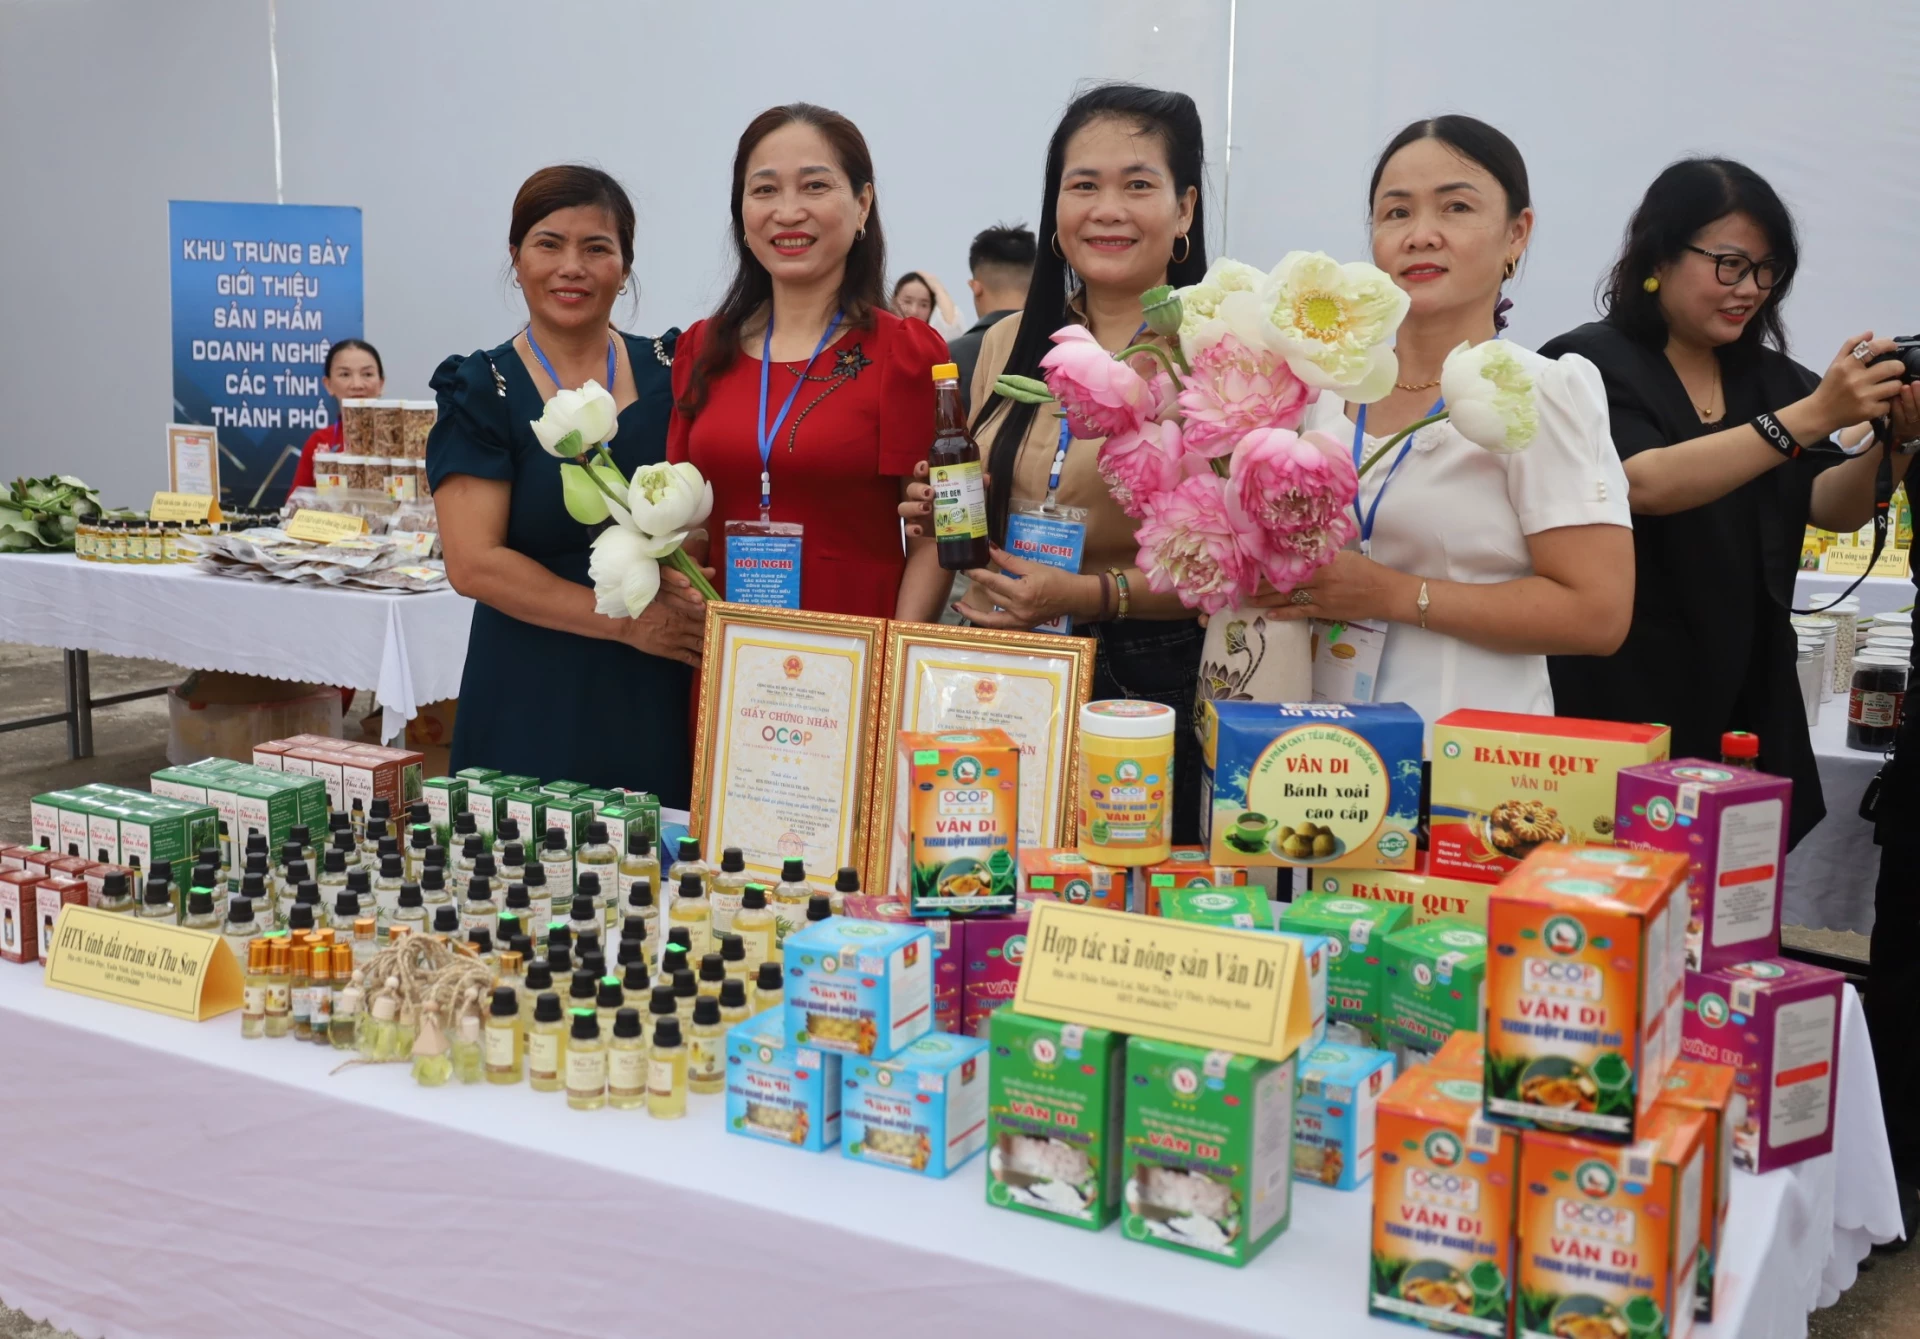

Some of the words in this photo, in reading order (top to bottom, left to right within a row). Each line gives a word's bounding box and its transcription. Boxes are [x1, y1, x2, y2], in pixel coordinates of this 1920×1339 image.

[183, 239, 225, 261] KHU
[232, 241, 302, 264] TRƯNG
[309, 237, 350, 265] BÀY
[217, 268, 254, 295] GIỚI
[262, 271, 318, 298] THIỆU
[214, 301, 257, 329] SẢN
[263, 297, 322, 331] PHẨM
[192, 340, 265, 362] DOANH
[271, 338, 331, 364] NGHIÊ
[225, 369, 266, 395] CÁC
[273, 368, 319, 396] TỈNH
[211, 400, 282, 428] THÀNH
[288, 399, 328, 430] PHỐ
[1013, 538, 1038, 552] HỘI
[1039, 543, 1073, 560] NGHỊ
[734, 556, 758, 570] HỘI
[760, 558, 793, 571] NGHỊ
[741, 705, 766, 719] GIẤY
[769, 711, 804, 724] CHỨNG
[806, 716, 838, 730] NHẬN
[1286, 753, 1323, 773] VÂN
[1330, 758, 1349, 774] DI
[1474, 744, 1541, 768] BÁNH
[1548, 754, 1599, 777] QUY
[1111, 787, 1145, 796] OCOP
[1284, 783, 1328, 798] Bánh
[1335, 783, 1370, 798] xoài
[1511, 774, 1539, 790] VÂN
[1543, 779, 1559, 793] DI
[944, 791, 989, 803] OCOP
[936, 817, 971, 833] VÂN
[979, 820, 997, 833] DI
[1106, 811, 1130, 821] VÂN
[1134, 813, 1146, 821] DI
[1305, 808, 1334, 820] cao
[1340, 802, 1369, 823] cấp
[1378, 841, 1408, 849] HACCP
[1352, 882, 1415, 904] BÁNH
[1422, 894, 1470, 915] QUY
[61, 926, 84, 949] HTX
[104, 931, 122, 960] dầu
[159, 947, 178, 972] Thu
[177, 952, 199, 977] Sơn
[1042, 924, 1077, 965] Hợp
[1081, 931, 1107, 962] tác
[1110, 939, 1131, 967] xã
[1133, 942, 1176, 981] nông
[1180, 947, 1209, 979] sản
[1215, 952, 1250, 986] Vân
[1253, 959, 1277, 990] Di
[1530, 960, 1597, 985] OCOP
[1342, 997, 1362, 1011] DI
[1517, 998, 1570, 1024] VÂN
[1580, 1006, 1607, 1027] DI
[1397, 1015, 1428, 1037] VÂN
[1682, 1036, 1718, 1061] VÂN
[1721, 1047, 1743, 1065] DI
[1010, 1099, 1050, 1123] VÂN
[1055, 1110, 1077, 1128] DI
[1148, 1129, 1191, 1155] VÂN
[1196, 1142, 1220, 1161] DI
[1411, 1168, 1473, 1192] OCOP
[1400, 1203, 1447, 1230] VÂN
[1456, 1216, 1483, 1236] DI
[1561, 1201, 1629, 1226] OCOP
[1550, 1236, 1601, 1263] VÂN
[1611, 1249, 1640, 1269] DI
